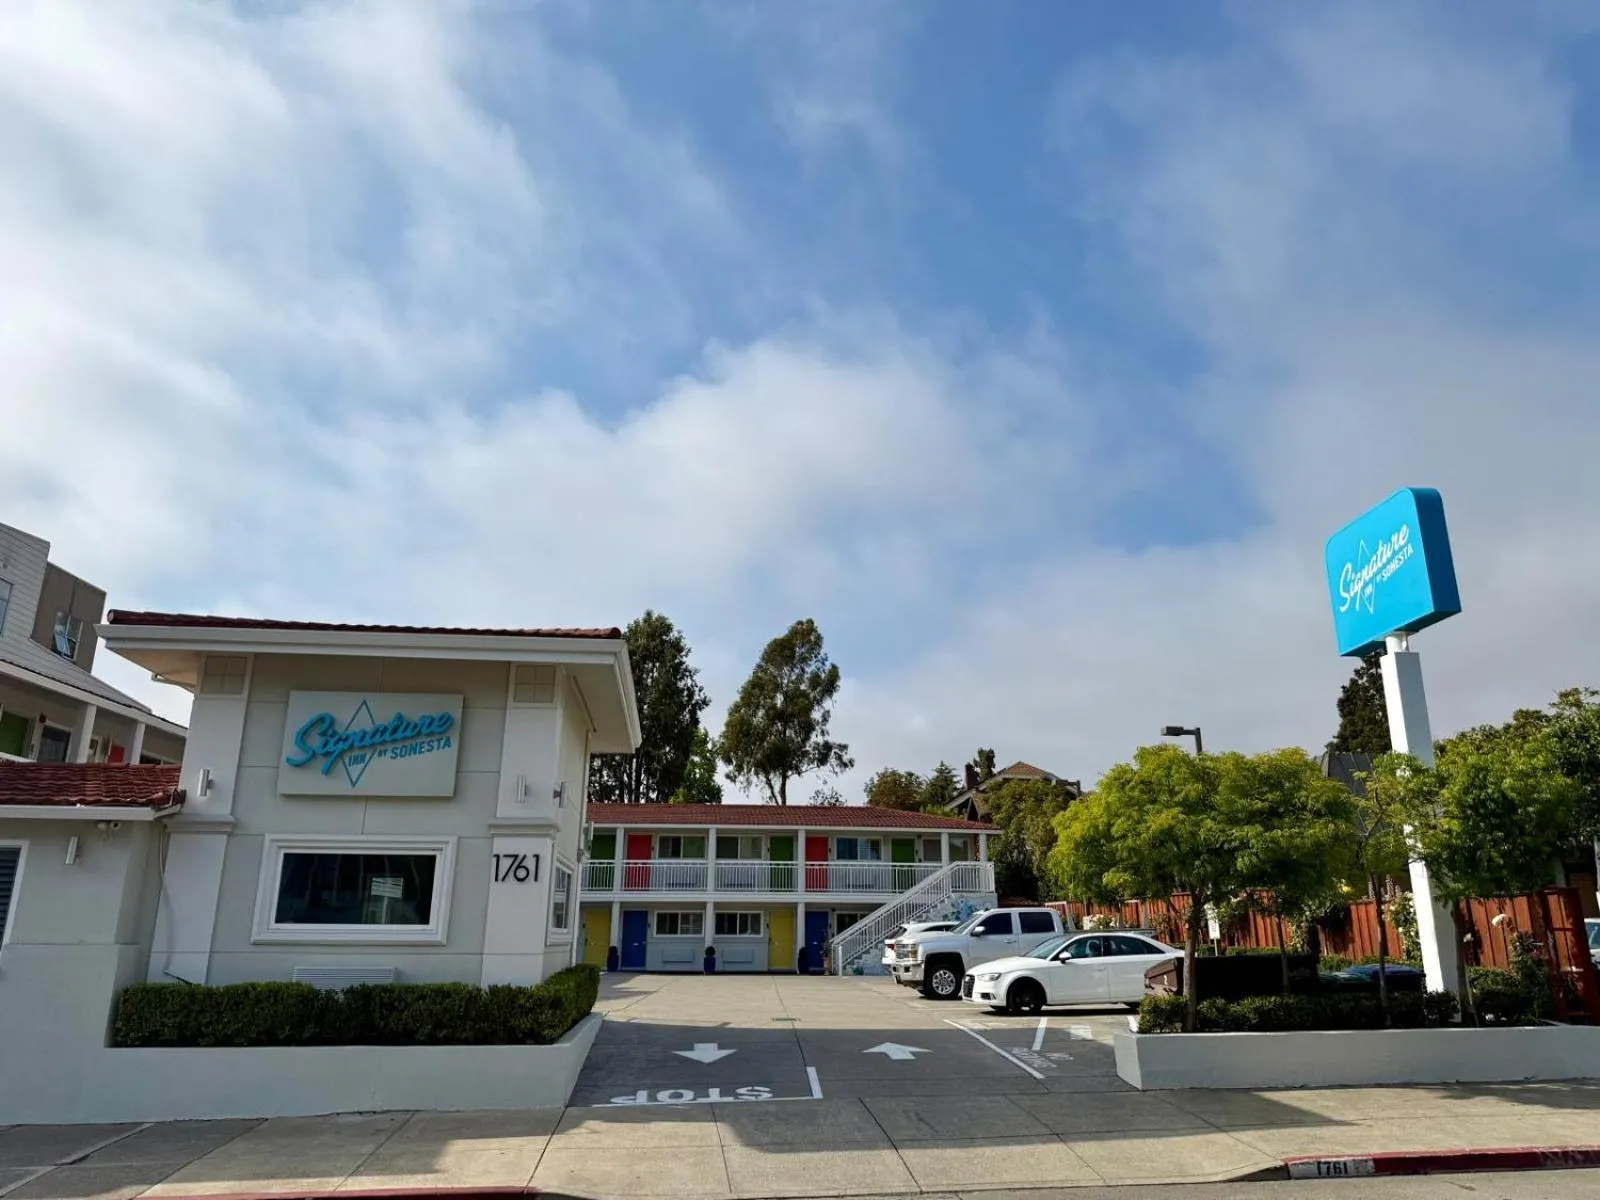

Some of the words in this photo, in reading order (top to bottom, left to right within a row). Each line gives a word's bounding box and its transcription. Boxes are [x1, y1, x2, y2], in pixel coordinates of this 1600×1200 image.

[1339, 523, 1409, 613] Signature
[1381, 543, 1414, 582] SONESTA
[286, 711, 455, 776] Signature
[348, 752, 367, 767] INN
[390, 735, 452, 760] SONESTA
[493, 853, 540, 882] 1761
[610, 1086, 774, 1104] STOP
[1316, 1161, 1348, 1176] 1761
